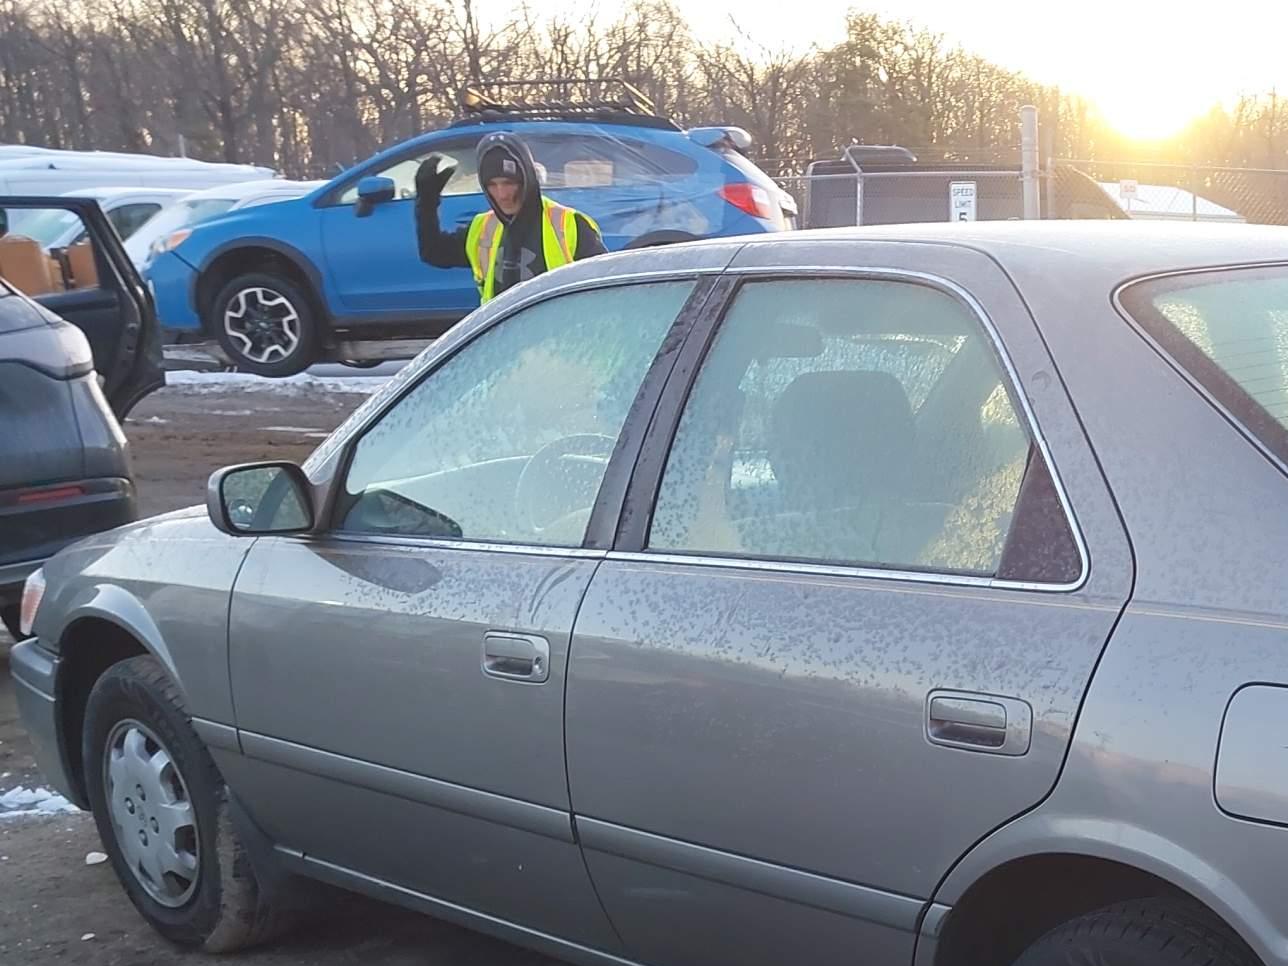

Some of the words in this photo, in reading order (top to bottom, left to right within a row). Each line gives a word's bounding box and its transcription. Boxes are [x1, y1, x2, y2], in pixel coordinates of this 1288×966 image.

[953, 188, 974, 196] SPEED
[955, 200, 972, 208] LIMIT
[959, 212, 968, 222] 5
